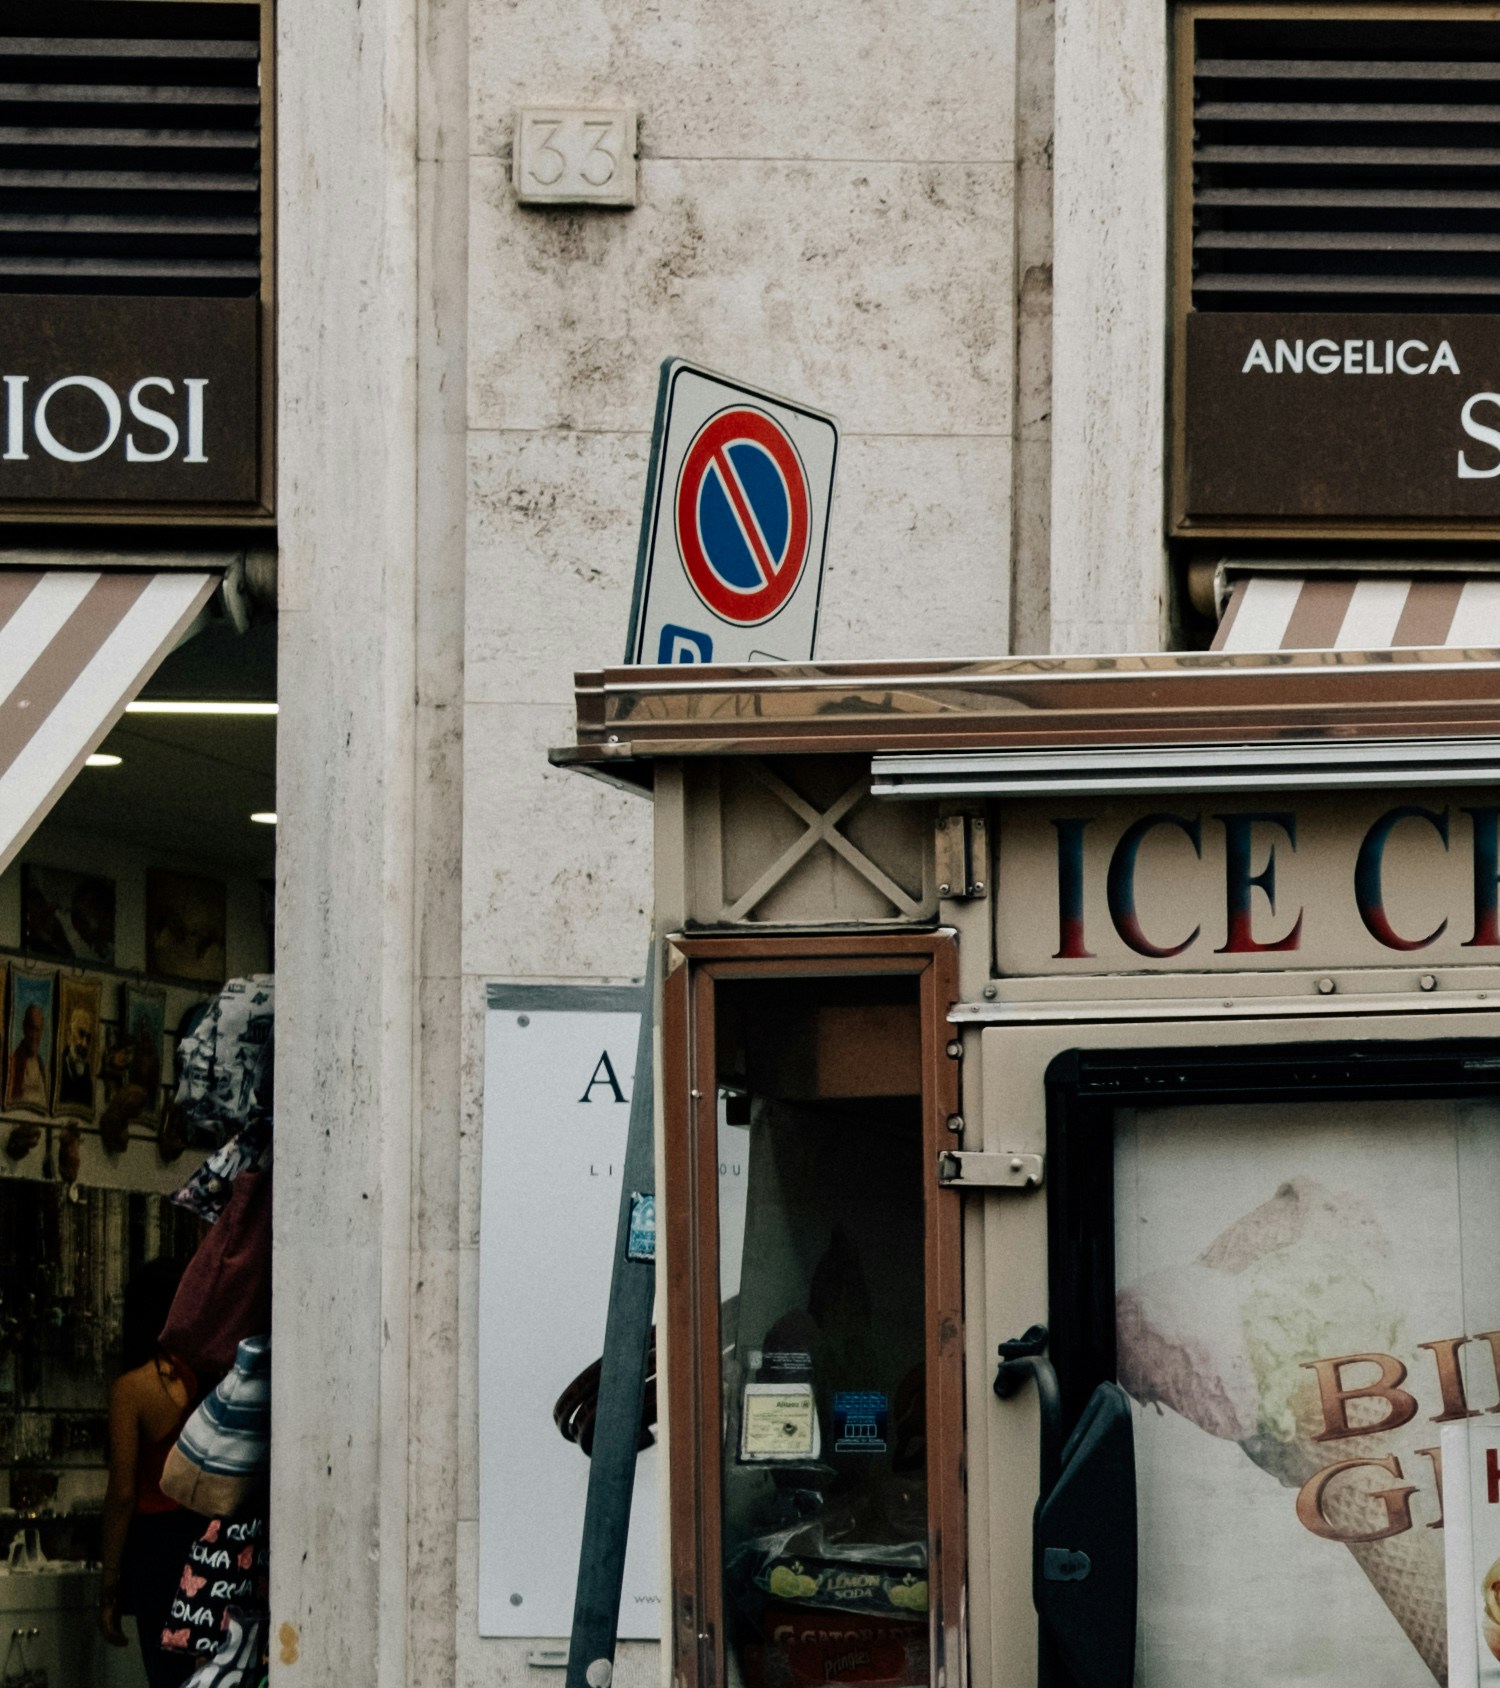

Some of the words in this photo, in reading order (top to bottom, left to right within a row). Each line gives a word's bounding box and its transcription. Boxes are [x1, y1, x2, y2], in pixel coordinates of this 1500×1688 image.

[527, 118, 616, 188] 33
[1242, 338, 1460, 375] ANGELICA
[2, 375, 210, 463] IOSI
[1051, 809, 1305, 960] ICE
